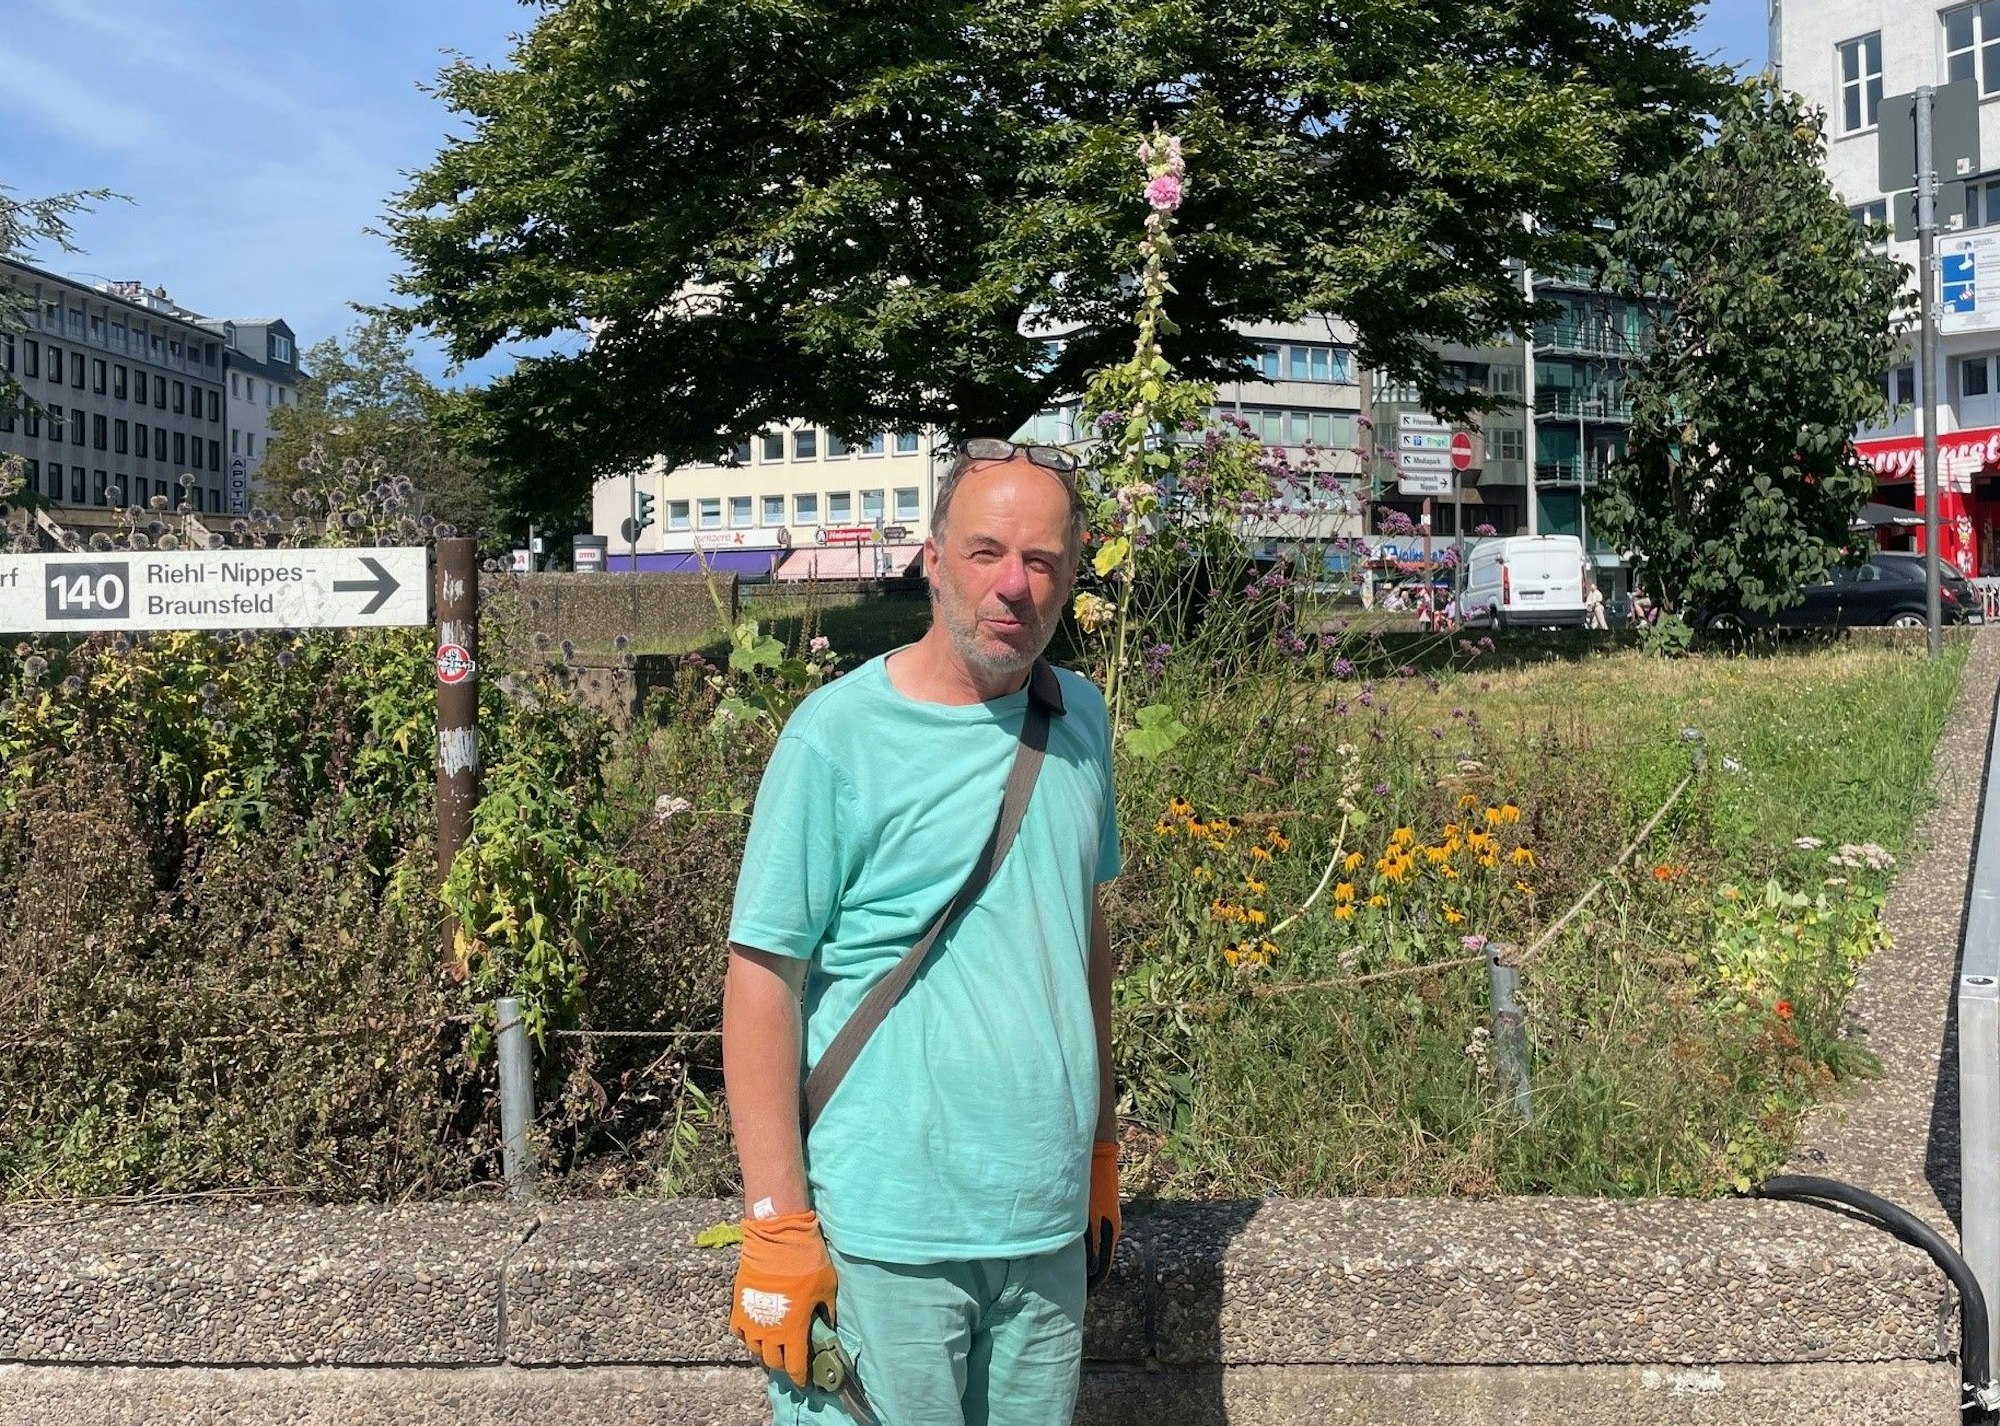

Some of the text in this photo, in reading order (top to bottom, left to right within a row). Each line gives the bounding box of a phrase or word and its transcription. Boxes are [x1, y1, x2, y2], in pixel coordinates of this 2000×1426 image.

[147, 562, 317, 587] Riehl-Nippes-
[50, 573, 125, 611] 140
[148, 593, 274, 615] Braunsfeld
